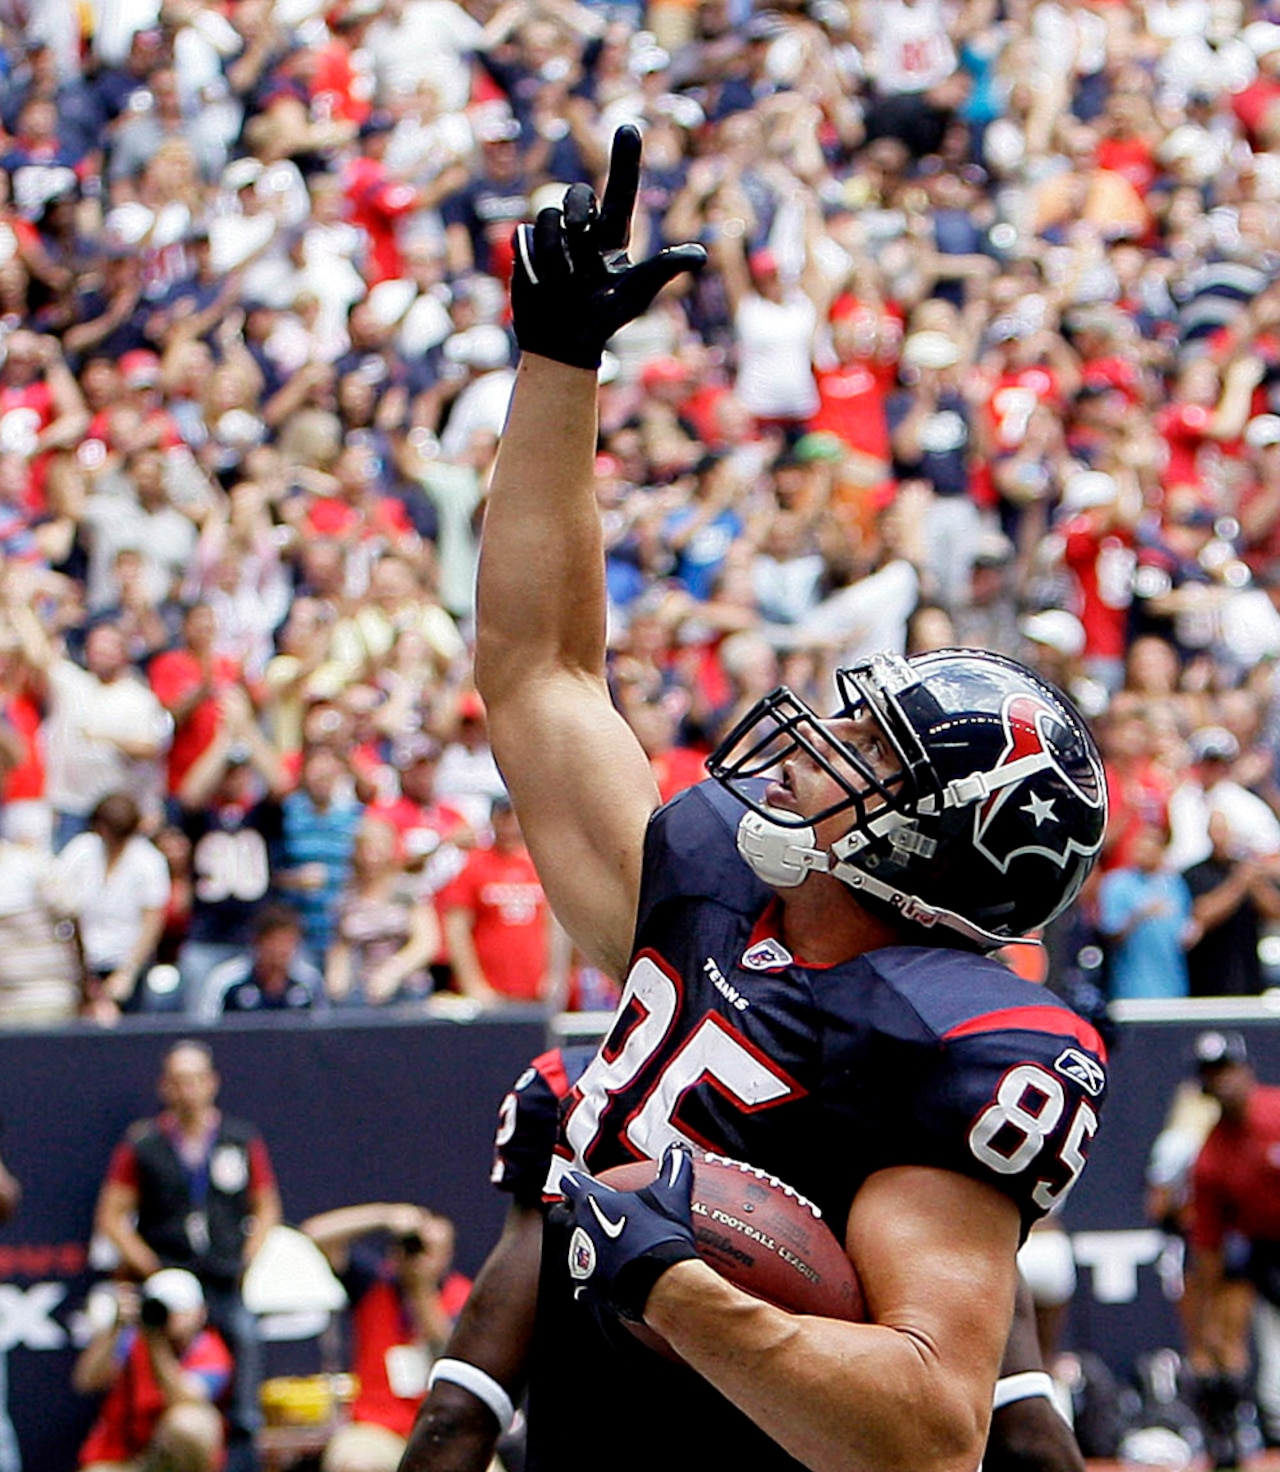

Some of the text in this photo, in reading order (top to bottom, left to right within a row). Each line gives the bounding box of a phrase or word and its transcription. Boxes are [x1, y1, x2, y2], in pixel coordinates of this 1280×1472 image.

[702, 956, 750, 1011] TEXANS
[967, 1063, 1099, 1210] 85
[711, 1209, 776, 1251] FOOTBALL
[777, 1246, 820, 1286] LEAGUE
